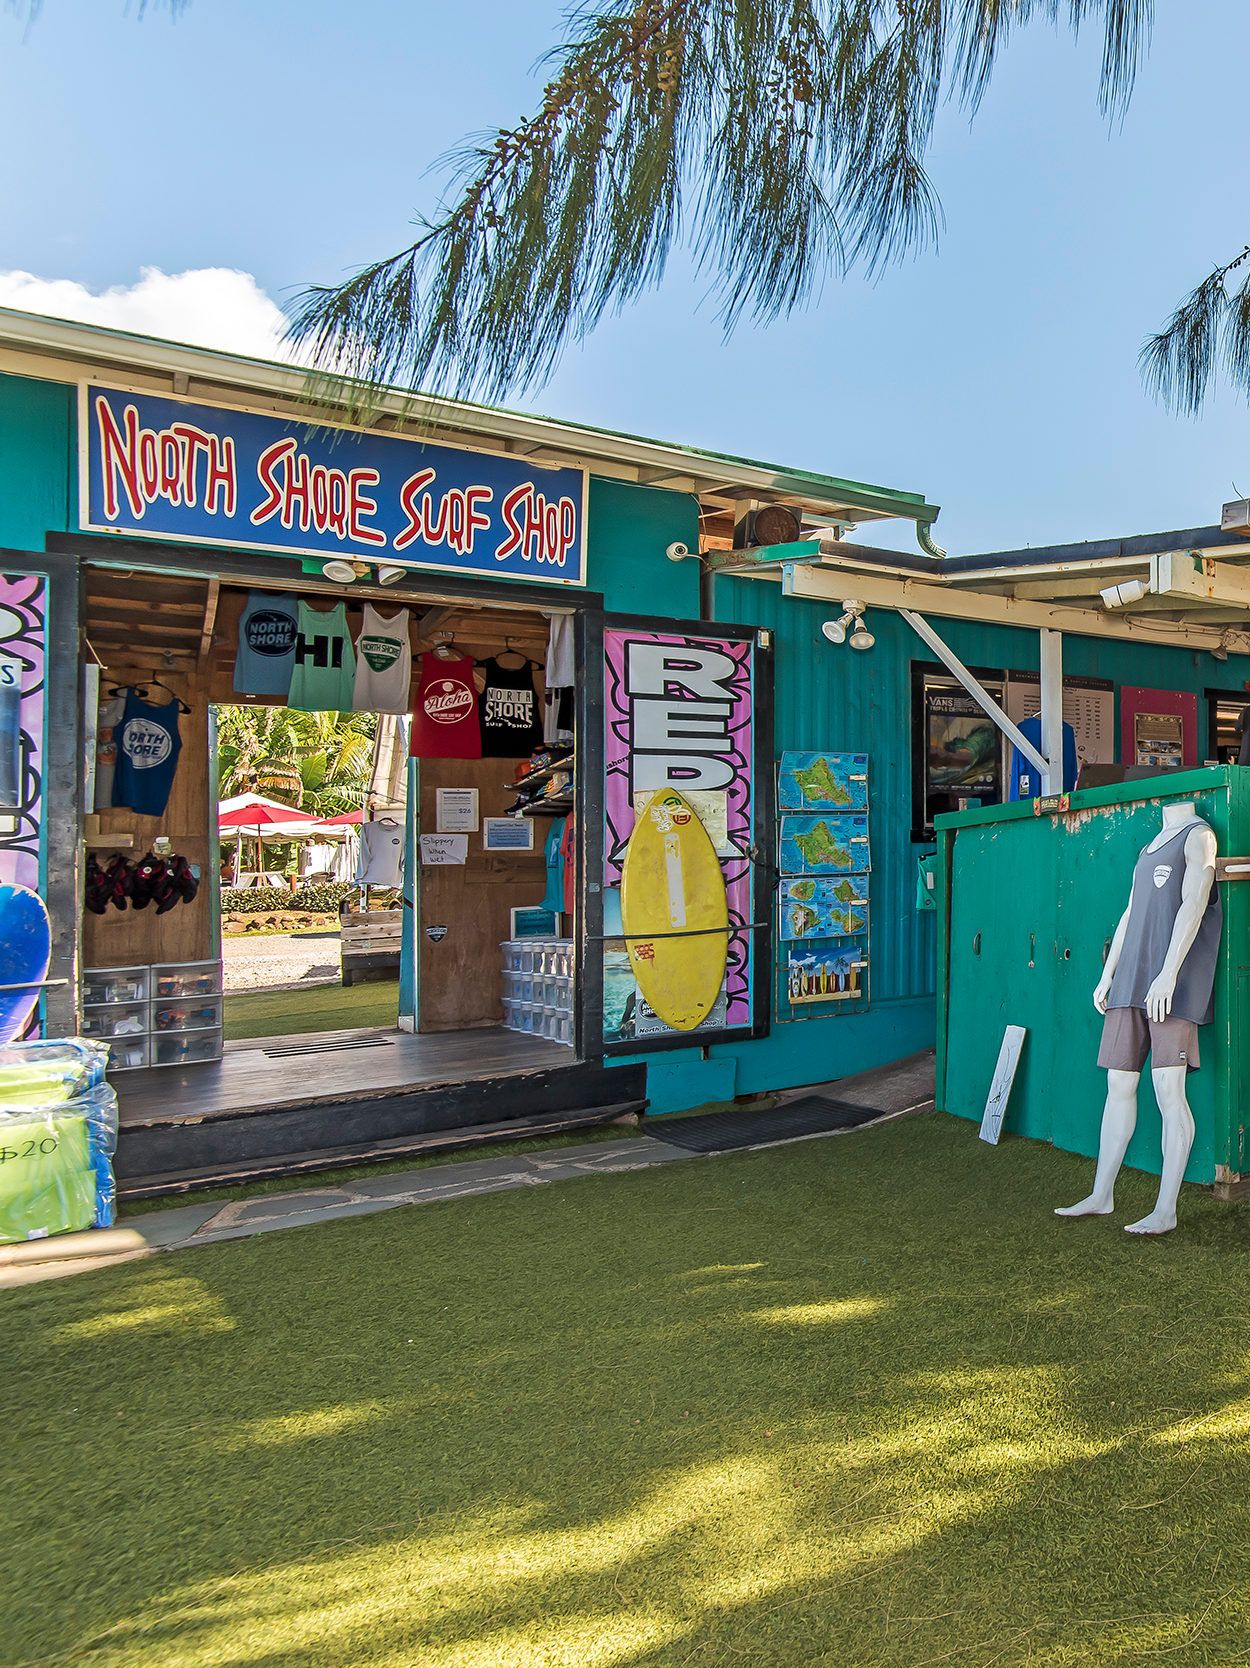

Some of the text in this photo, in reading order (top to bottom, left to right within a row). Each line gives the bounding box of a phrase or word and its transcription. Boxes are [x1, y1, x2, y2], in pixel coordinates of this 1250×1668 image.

[250, 621, 293, 634] NORTH
[249, 632, 292, 645] SHORE
[295, 632, 344, 668] HI
[425, 691, 470, 711] Aloha
[488, 689, 531, 702] NORTH
[929, 696, 953, 707] VANS
[485, 701, 533, 725] SHORE
[422, 837, 454, 847] Slippery
